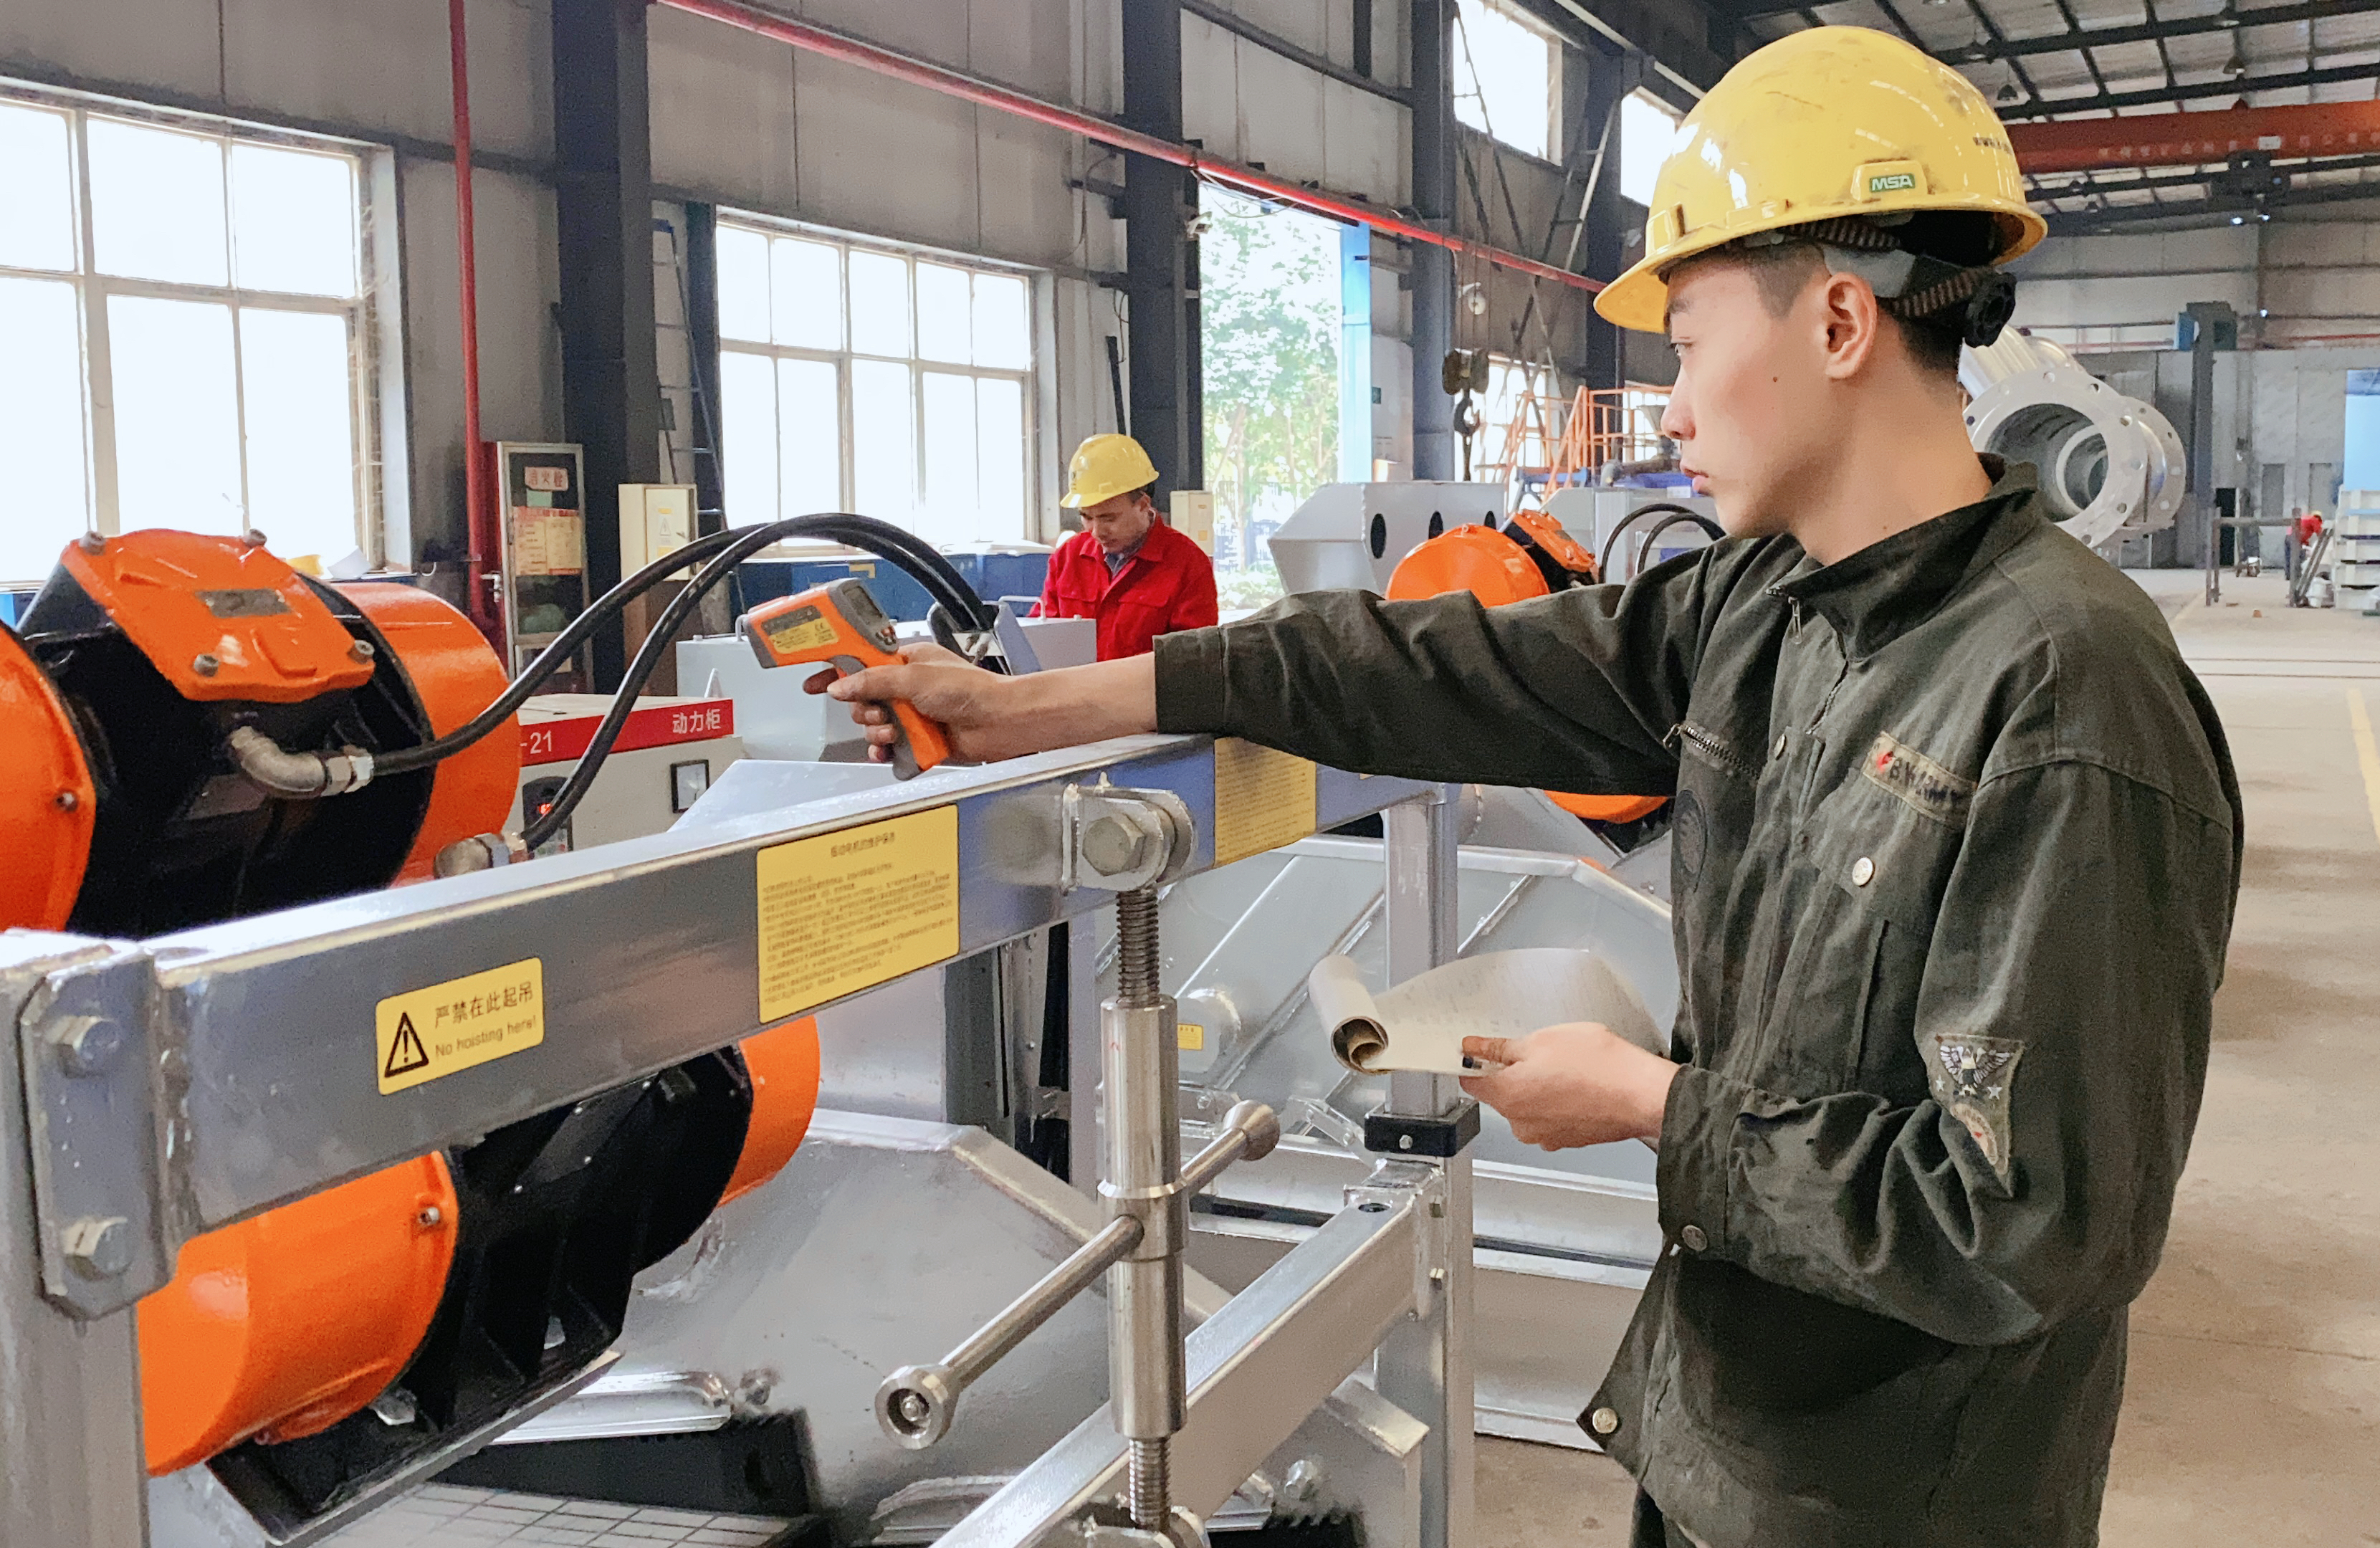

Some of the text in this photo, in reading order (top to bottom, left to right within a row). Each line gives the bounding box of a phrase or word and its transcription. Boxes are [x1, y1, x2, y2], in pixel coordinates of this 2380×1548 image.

[1871, 175, 1913, 191] MSA
[672, 708, 722, 735] 动力柜
[435, 980, 533, 1029] 严禁在此起吊
[435, 1015, 537, 1058] No hoisting here!
